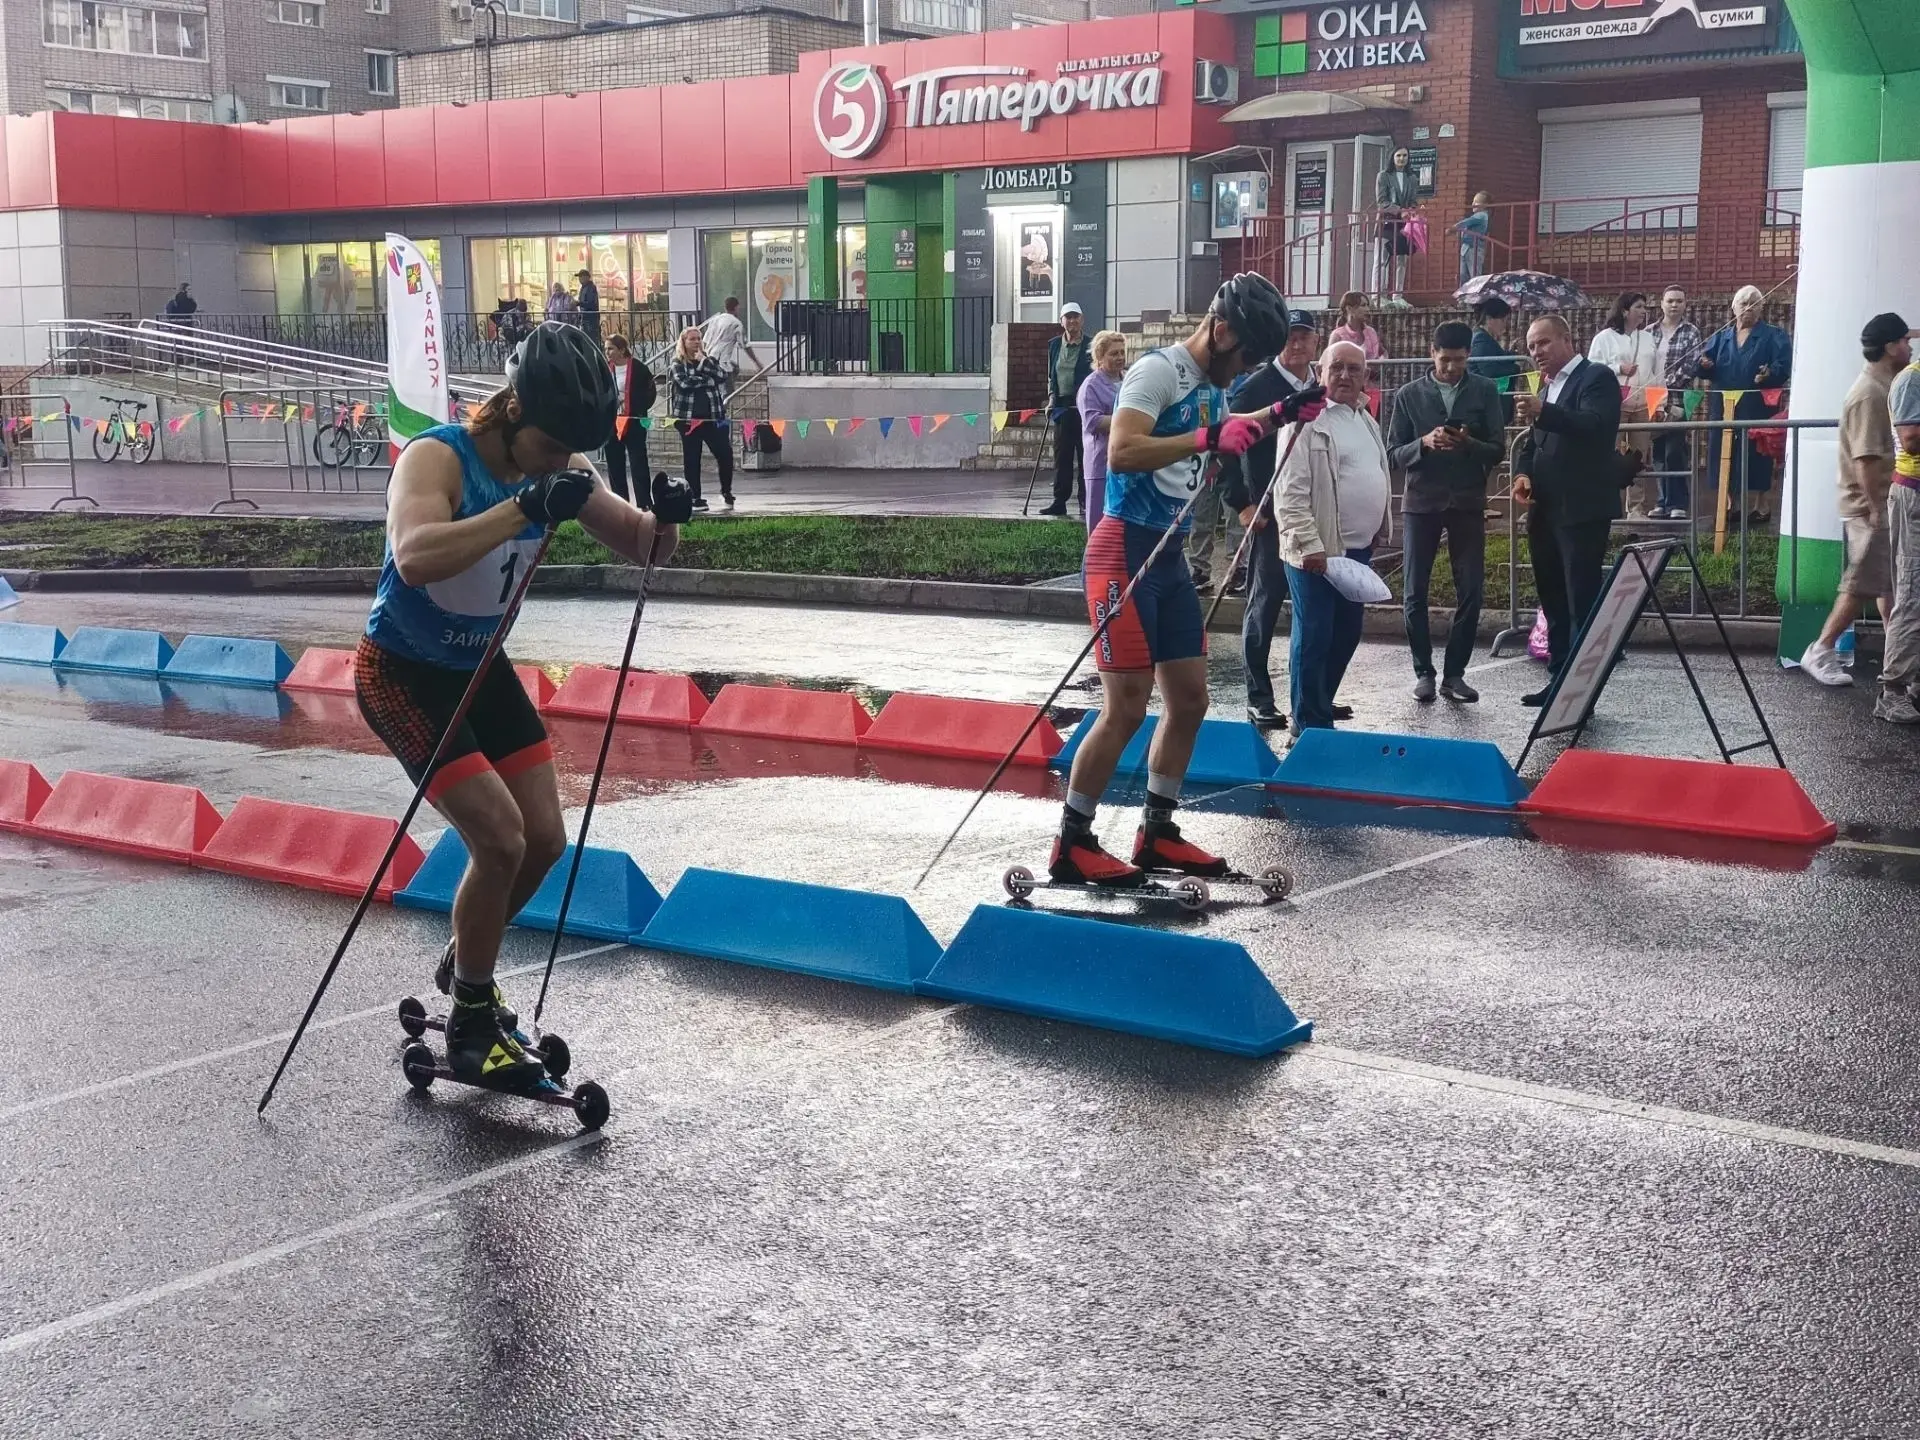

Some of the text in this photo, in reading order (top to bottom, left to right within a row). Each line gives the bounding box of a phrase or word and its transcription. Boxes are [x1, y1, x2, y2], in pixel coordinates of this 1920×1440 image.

[1317, 1, 1428, 41] ОКНА
[1525, 21, 1638, 41] женская одежда
[1709, 11, 1754, 25] сумки
[1055, 51, 1162, 73] АШАМЛЫКЛАР
[1362, 39, 1426, 67] ВЕКА
[892, 65, 1164, 133] Пятёрочка
[1077, 252, 1093, 262] 9-19
[1186, 454, 1202, 491] 3
[498, 552, 519, 605] 1
